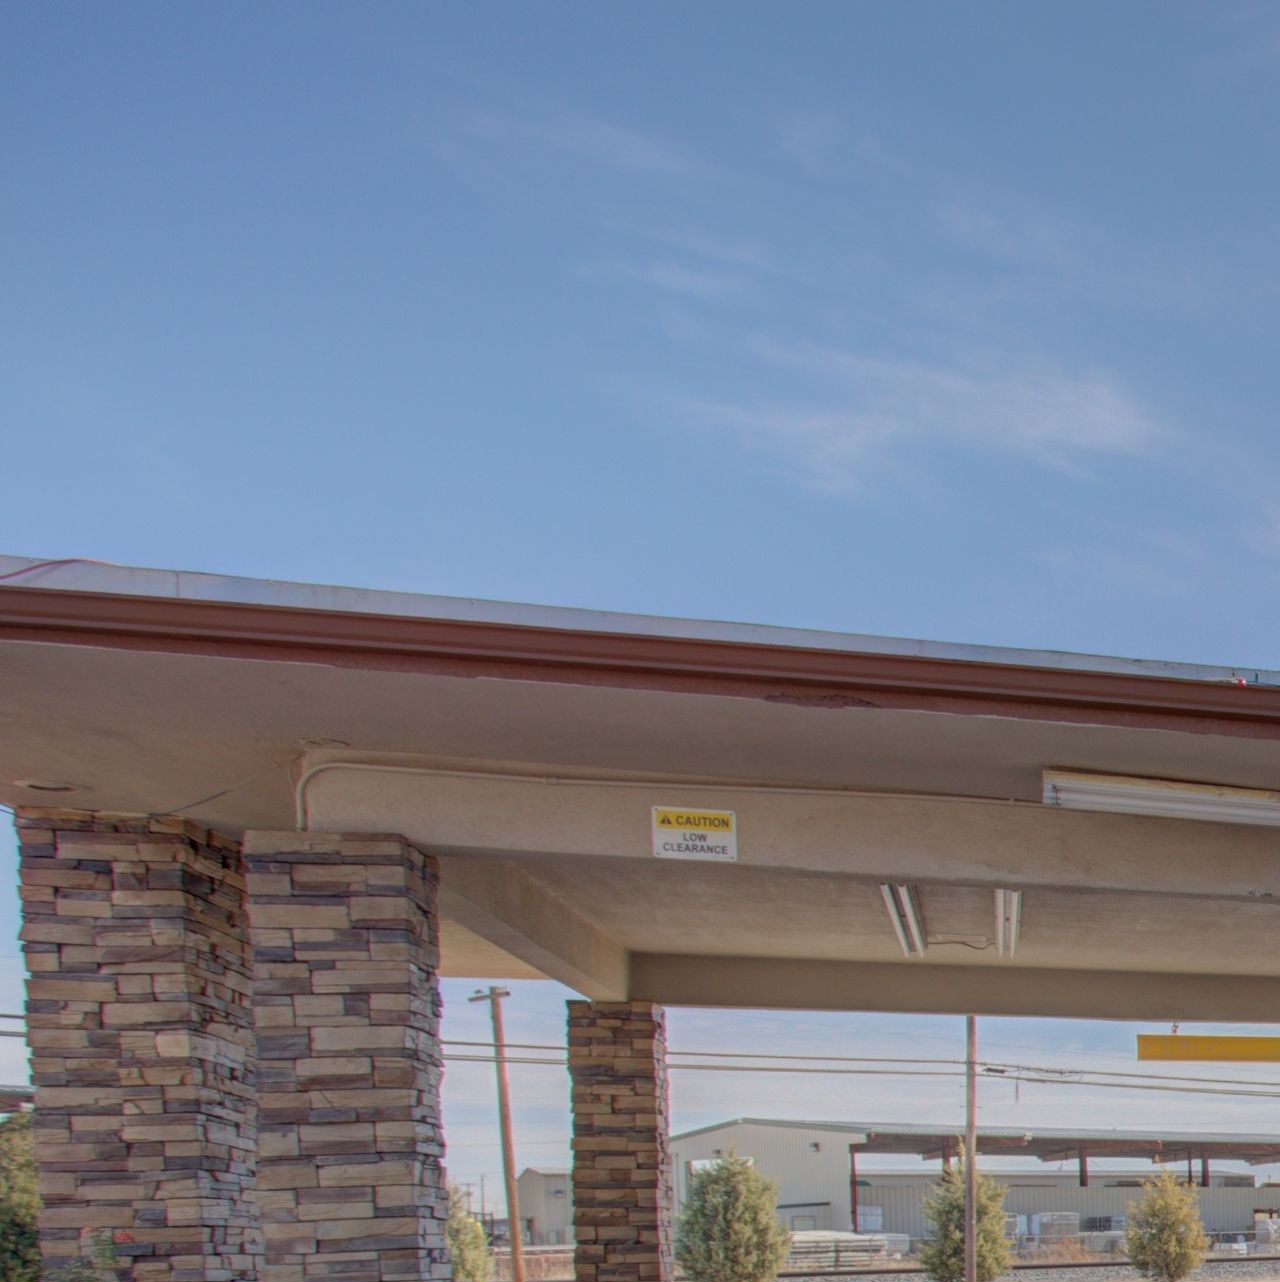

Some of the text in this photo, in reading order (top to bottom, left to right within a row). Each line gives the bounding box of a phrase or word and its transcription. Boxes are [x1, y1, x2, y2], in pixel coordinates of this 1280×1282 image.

[675, 815, 730, 828] CAUTION
[682, 833, 708, 842] LOW
[662, 842, 729, 855] CLEARANCE
